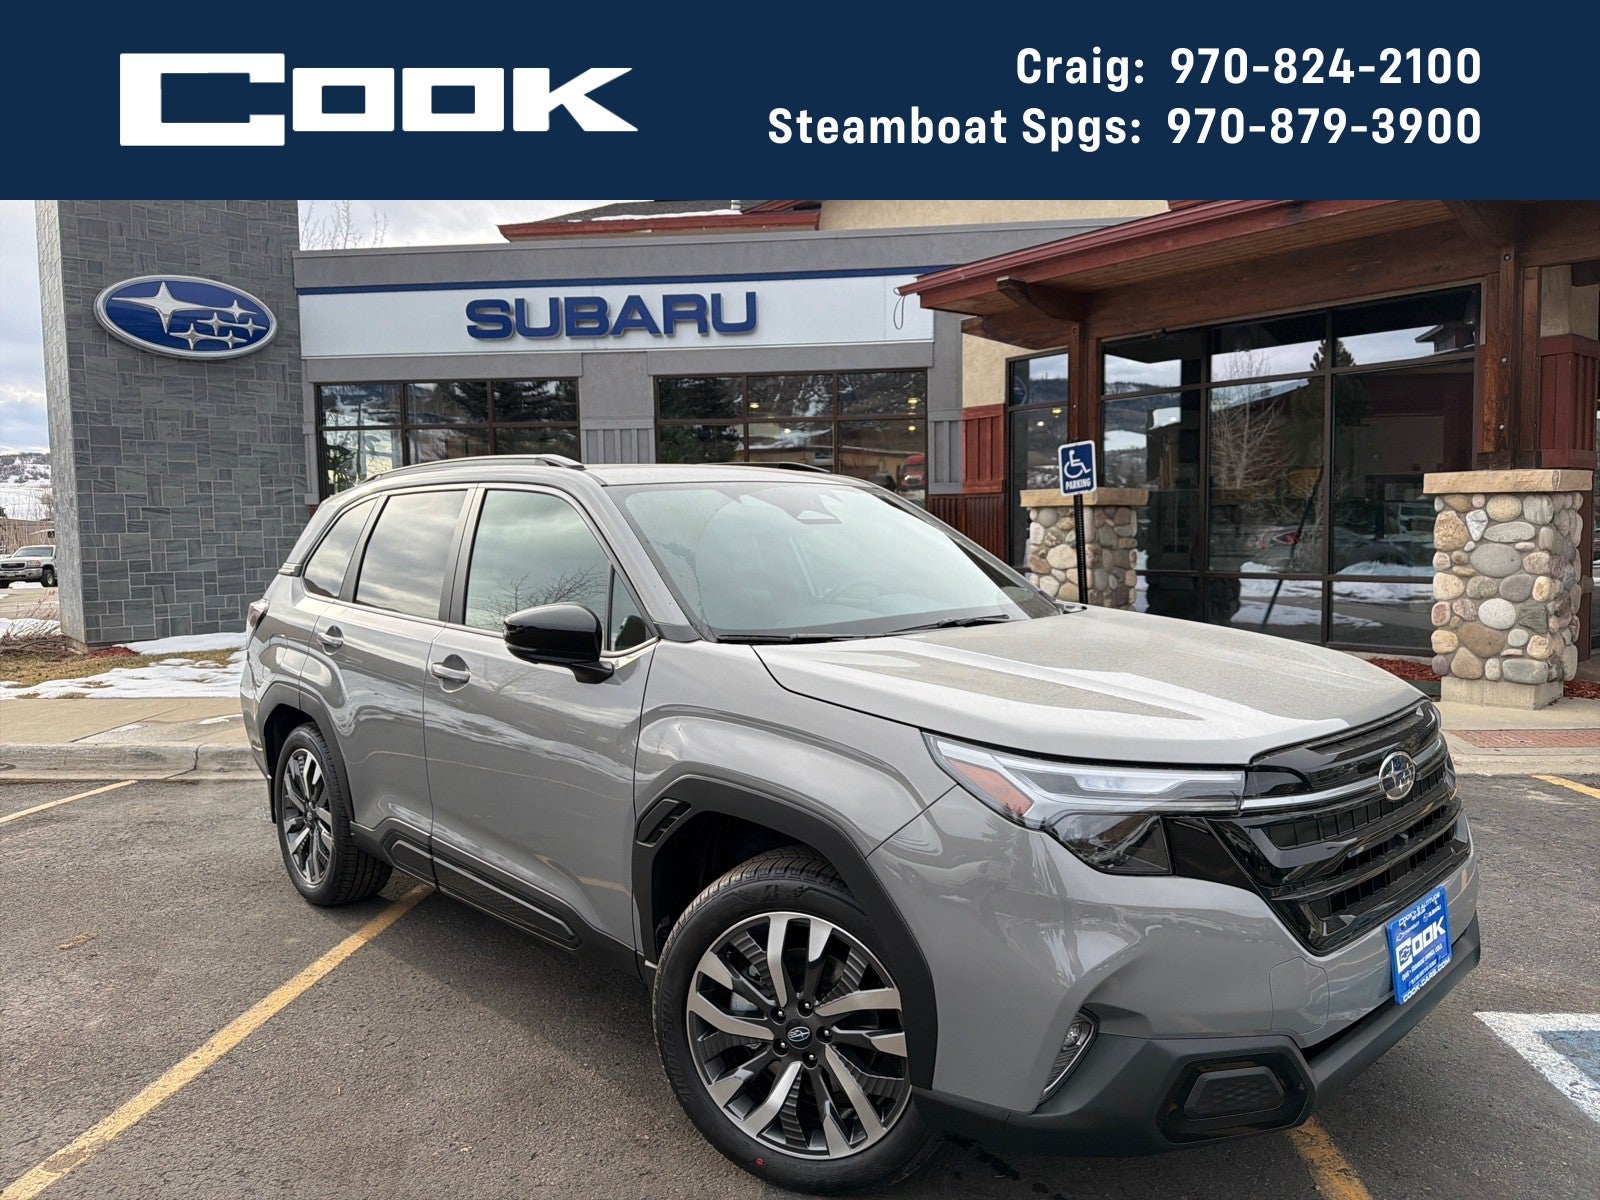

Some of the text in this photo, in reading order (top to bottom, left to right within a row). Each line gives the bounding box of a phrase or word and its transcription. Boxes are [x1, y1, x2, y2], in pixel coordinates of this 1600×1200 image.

[465, 291, 757, 340] SUBARU
[1065, 477, 1091, 491] PARKING
[1395, 915, 1446, 974] COOK
